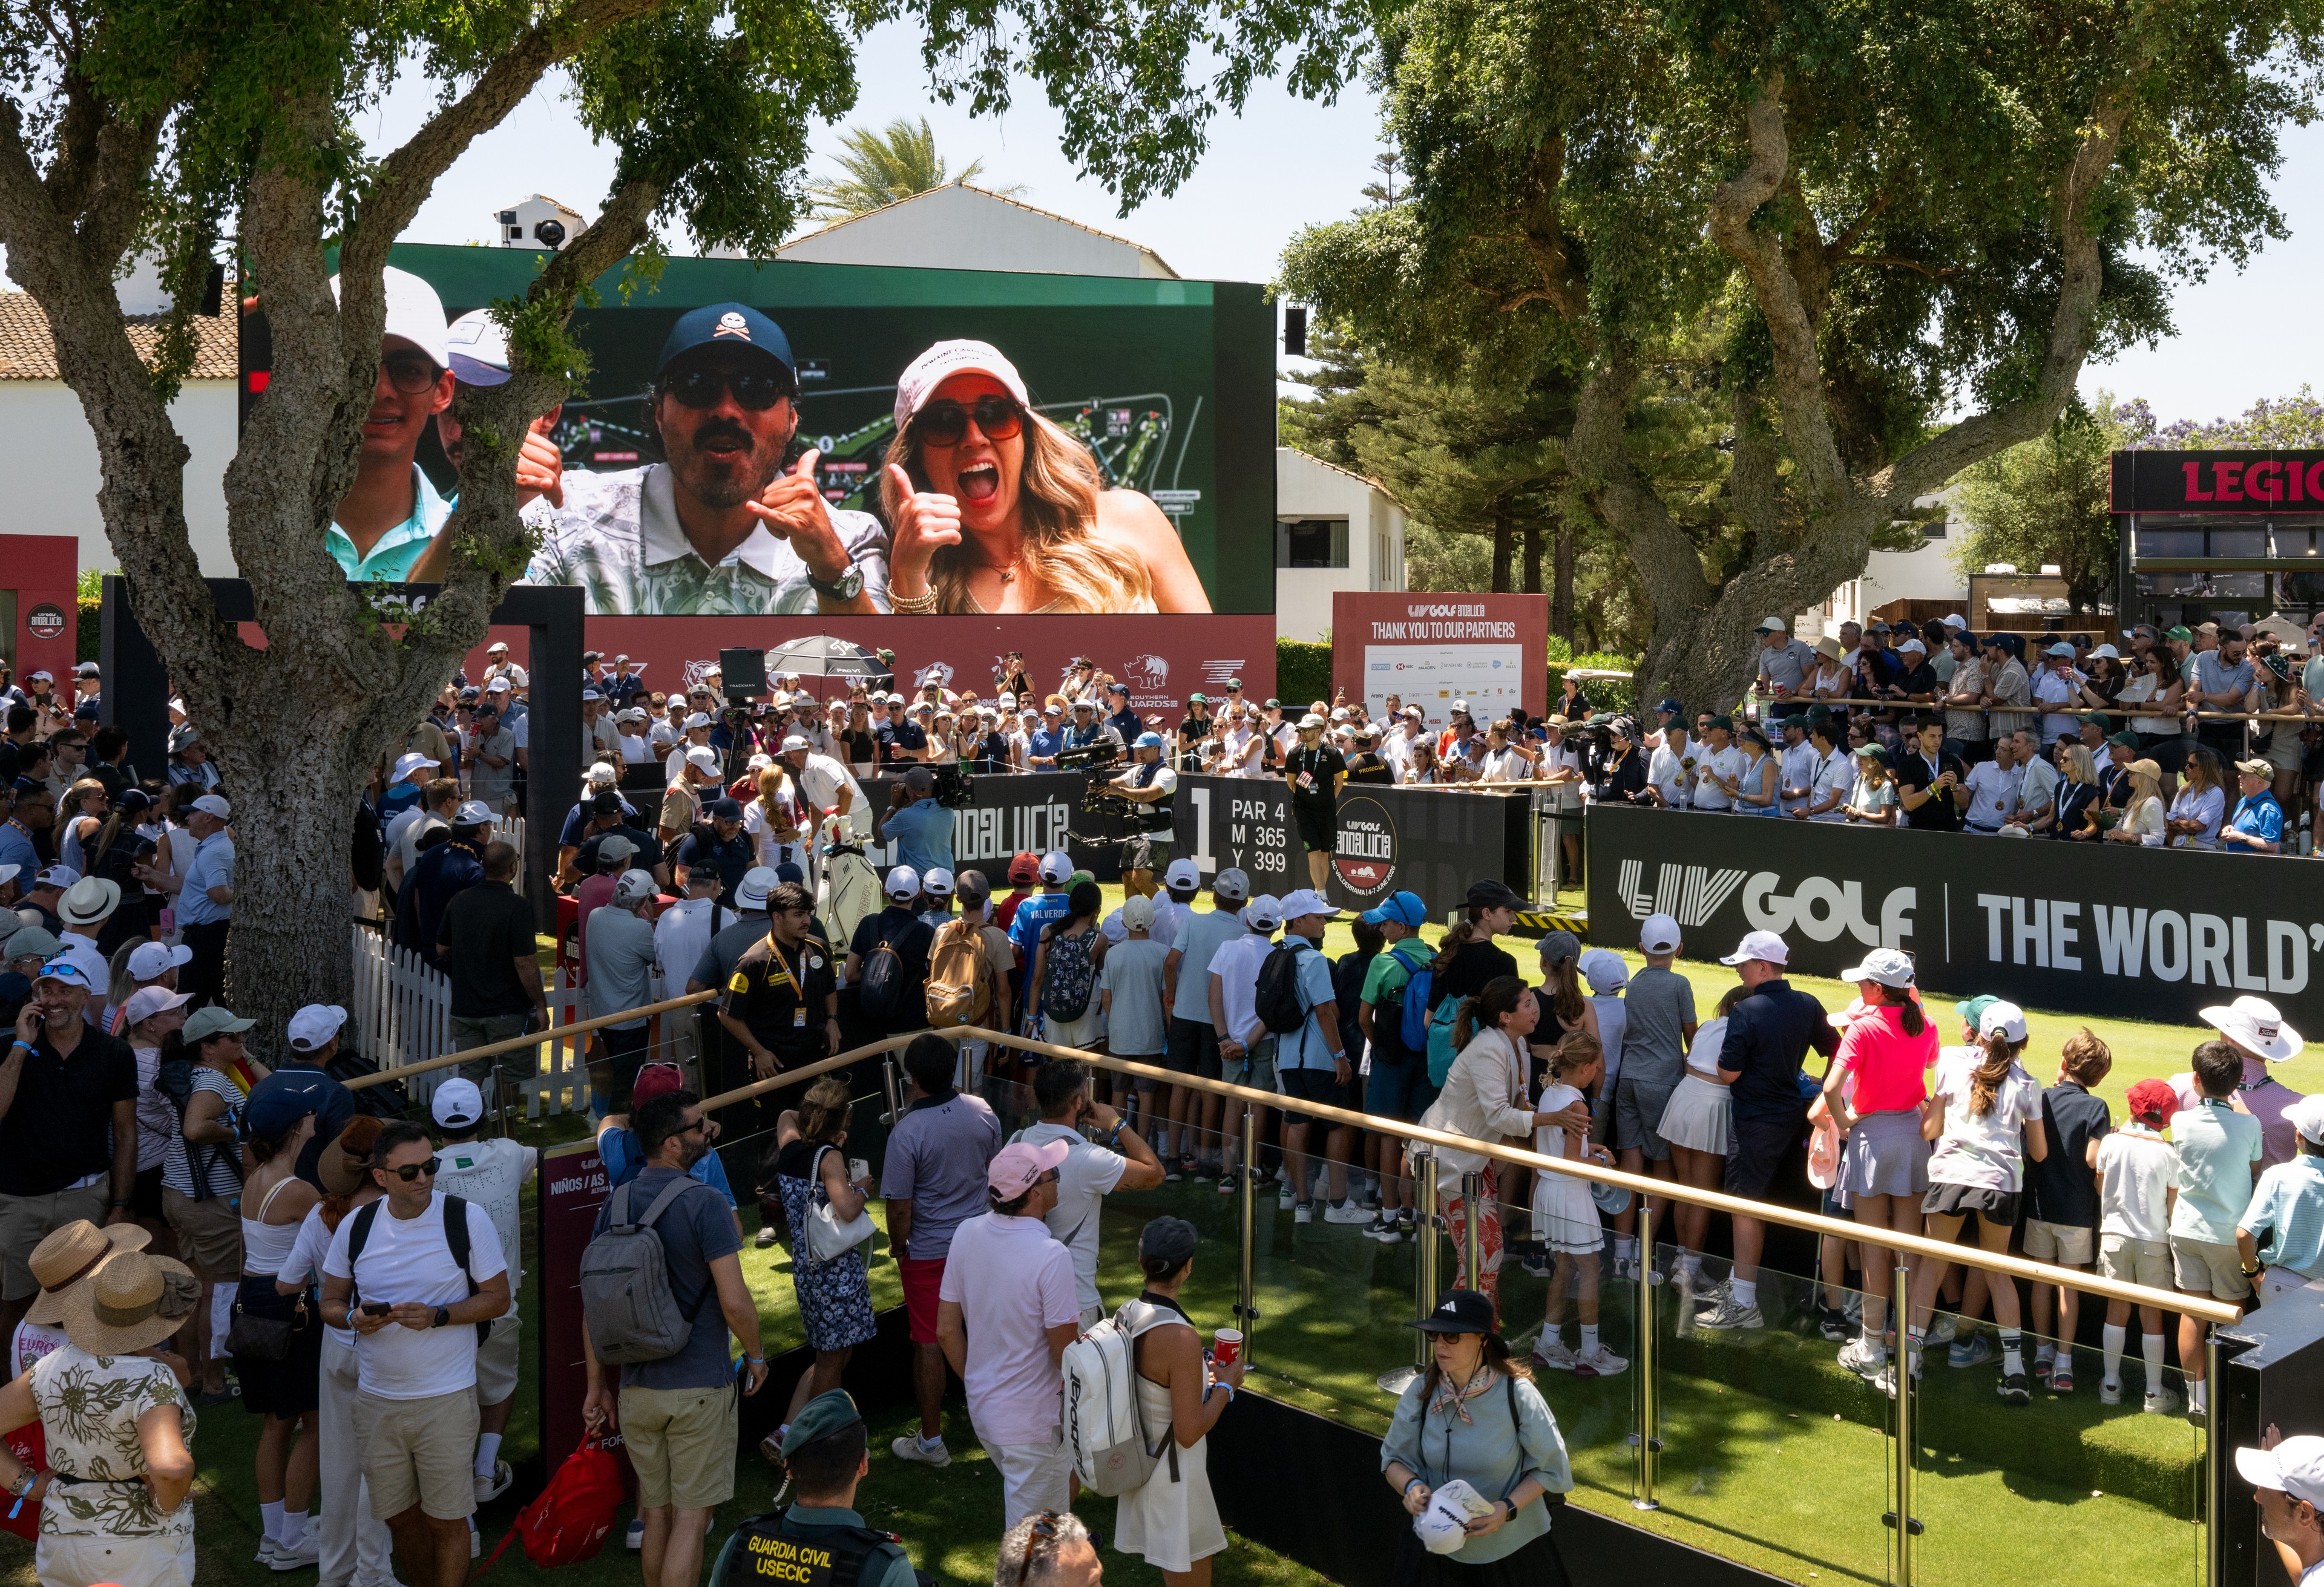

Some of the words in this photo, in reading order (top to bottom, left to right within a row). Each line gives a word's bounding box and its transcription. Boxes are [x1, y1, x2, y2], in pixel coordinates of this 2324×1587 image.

[1408, 604, 1430, 617] LIV
[1430, 604, 1456, 617] GOLF
[1371, 622, 1407, 639] THANK
[1408, 622, 1429, 639] YOU
[1430, 621, 1443, 638] TO
[1444, 621, 1465, 638] OUR
[1466, 621, 1515, 638] PARTNERS
[1359, 765, 1385, 774] PROSEGUR
[1232, 799, 1266, 820] PAR
[1275, 803, 1285, 822] 4
[1191, 787, 1216, 874] 1
[1232, 823, 1246, 844] M
[1255, 826, 1286, 848] 365
[1346, 820, 1362, 830] LIV
[1361, 822, 1380, 832] GOLF
[1232, 848, 1244, 868] Y
[1254, 851, 1286, 872] 399
[1331, 859, 1338, 871] RC
[1335, 869, 1365, 896] VALDERRAMA
[1368, 887, 1376, 895] 4-7
[1376, 880, 1389, 892] JUNE
[1386, 865, 1396, 882] 2026
[1031, 909, 1068, 919] VALVERDE
[1618, 859, 1748, 926] LIV
[1742, 871, 1916, 950] GOLF
[1977, 893, 2082, 971] THE
[2260, 1029, 2277, 1037] Titleist
[581, 1157, 602, 1170] LIV
[551, 1177, 583, 1196] NIÑOS
[591, 1173, 605, 1188] AS
[591, 1185, 609, 1194] ALTURA
[748, 1536, 796, 1561] GUARDIA
[799, 1547, 832, 1568] CIVIL
[757, 1557, 812, 1583] USECIC
